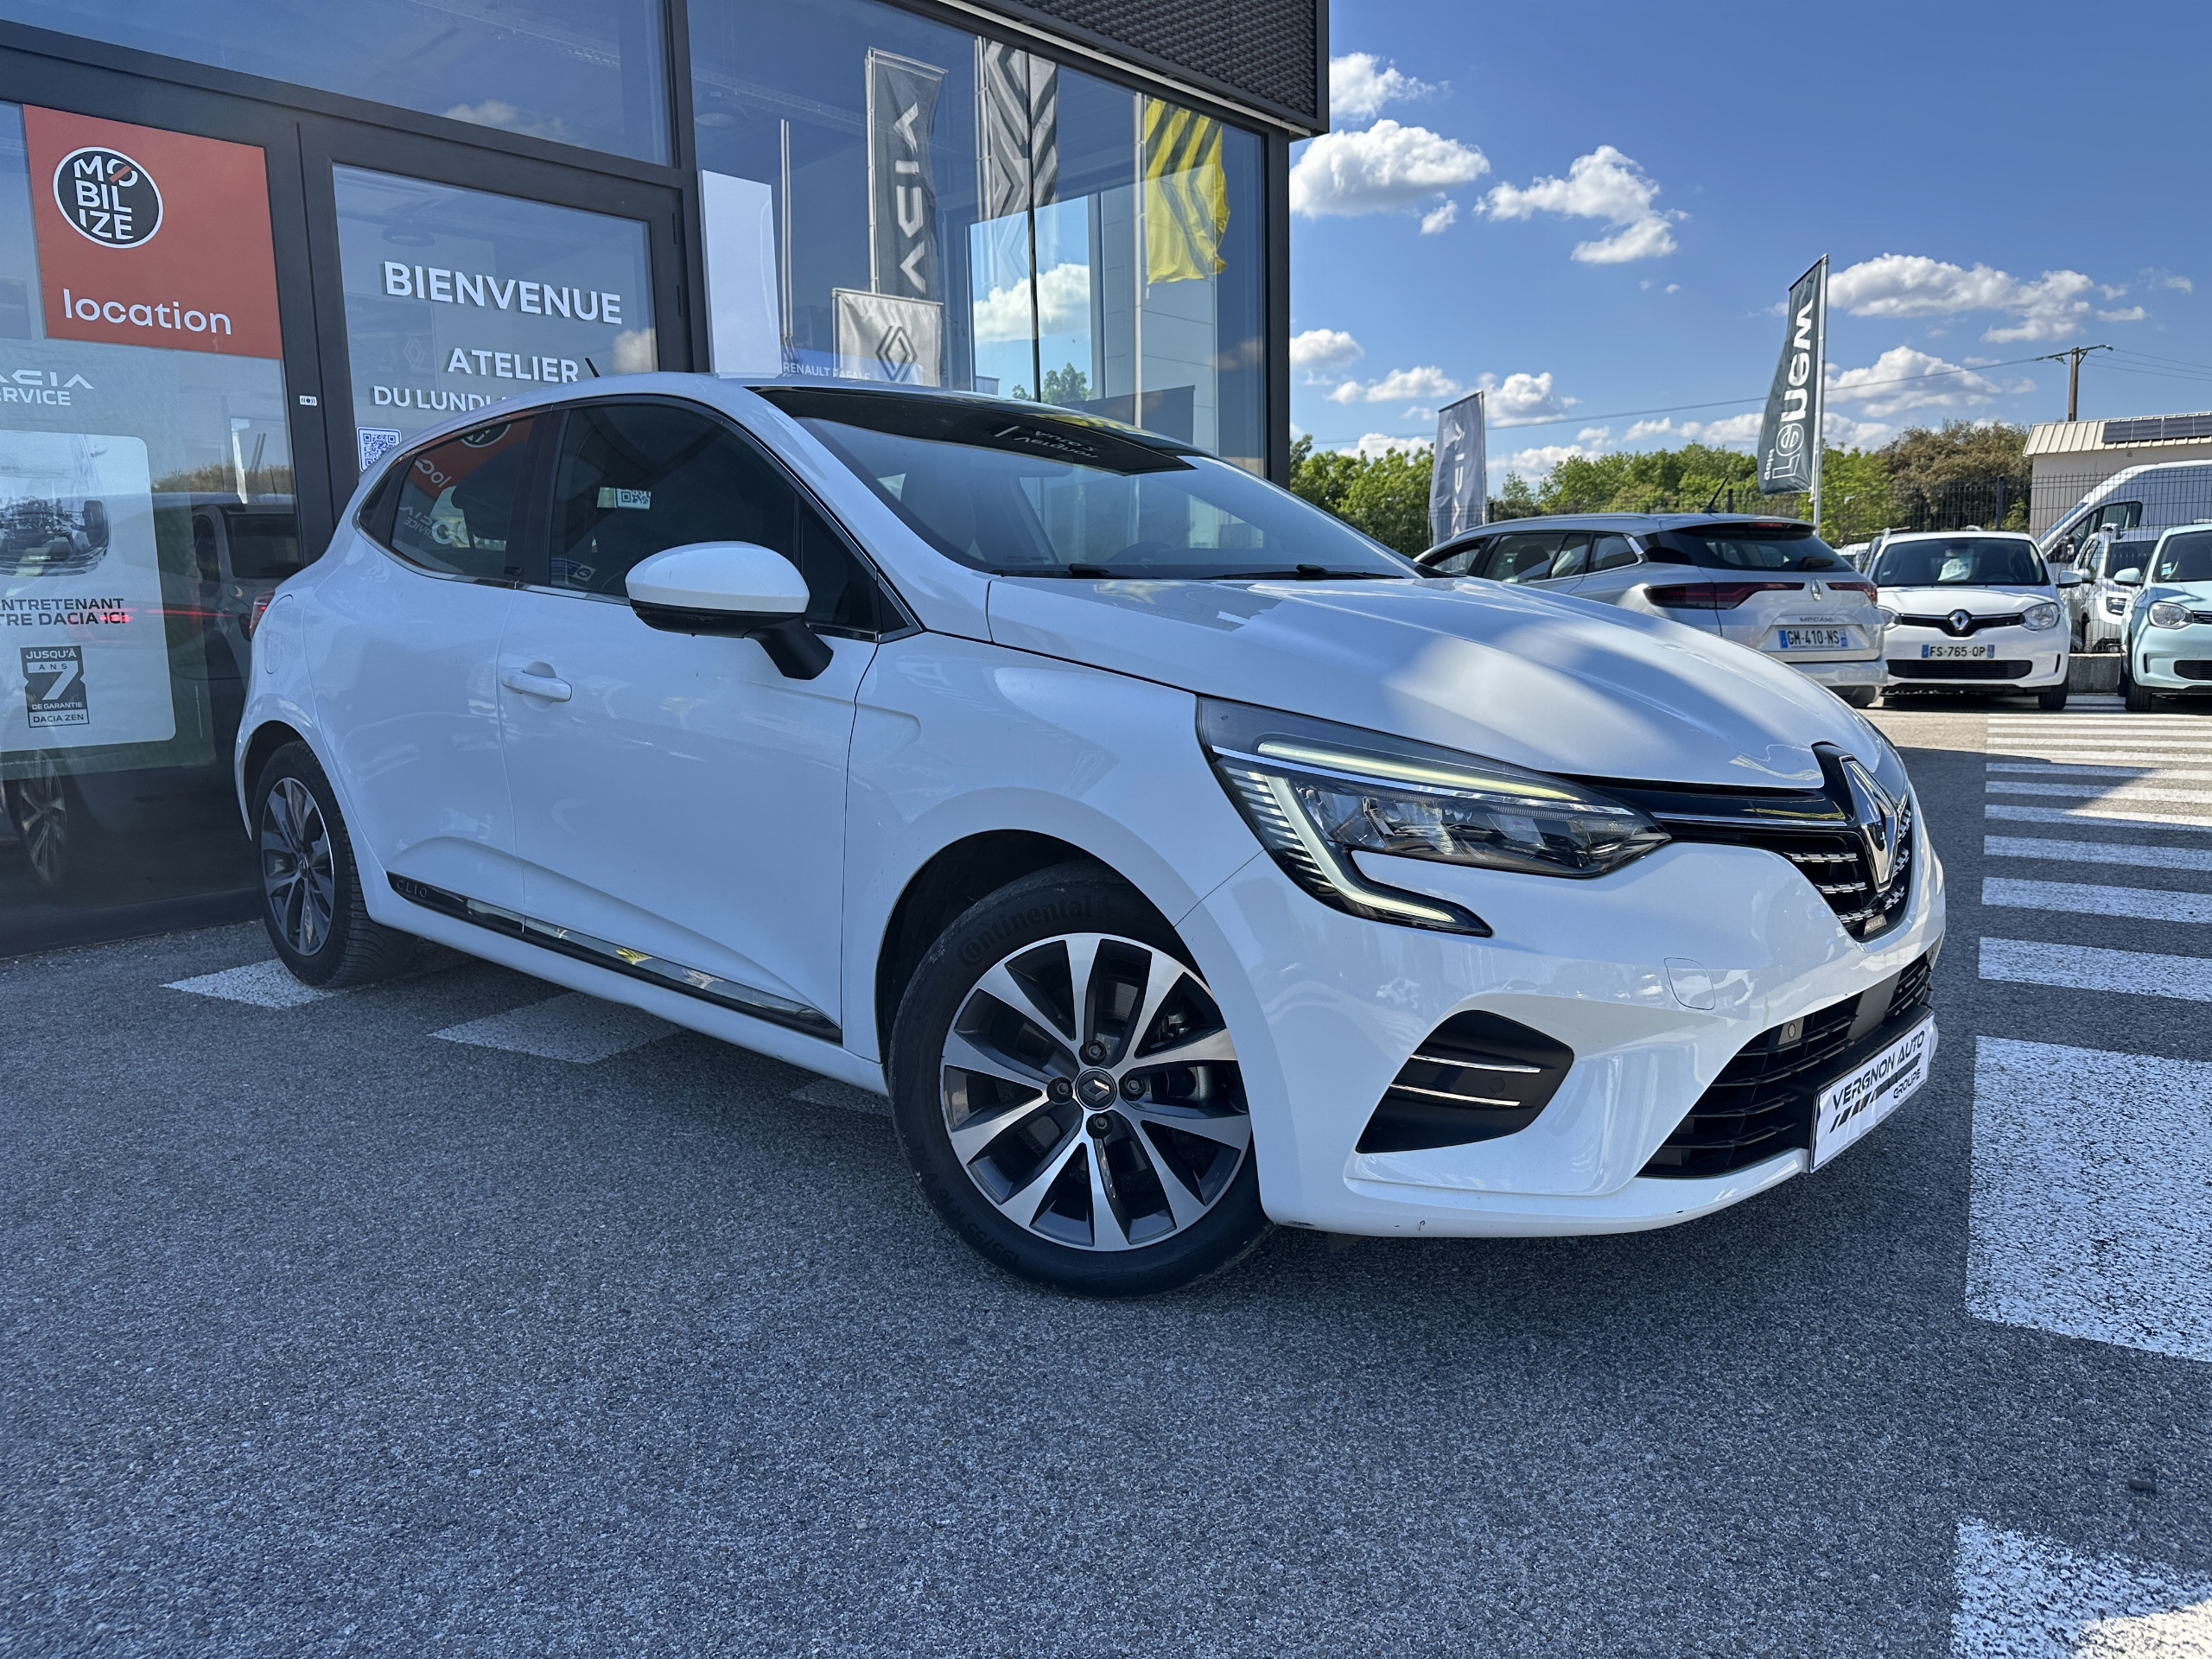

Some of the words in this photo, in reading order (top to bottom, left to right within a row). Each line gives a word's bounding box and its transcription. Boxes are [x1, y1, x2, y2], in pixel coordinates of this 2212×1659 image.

[75, 179, 133, 213] BIL
[893, 101, 927, 295] ACIA
[79, 208, 134, 240] IZE
[384, 261, 622, 325] BIENVENUE
[63, 288, 232, 335] location
[448, 347, 579, 384] ATELIER
[783, 362, 830, 377] RENAULT
[0, 386, 72, 406] RVICE
[373, 385, 410, 406] DU
[0, 598, 124, 611] NTRETENANT
[38, 612, 99, 626] DACIA
[103, 611, 126, 624] ICI
[27, 660, 79, 701] 7
[397, 880, 428, 899] CLIO
[1833, 1052, 1896, 1111] VERGNON
[1897, 1030, 1925, 1065] AUTO
[1893, 1067, 1922, 1099] GROUPE
